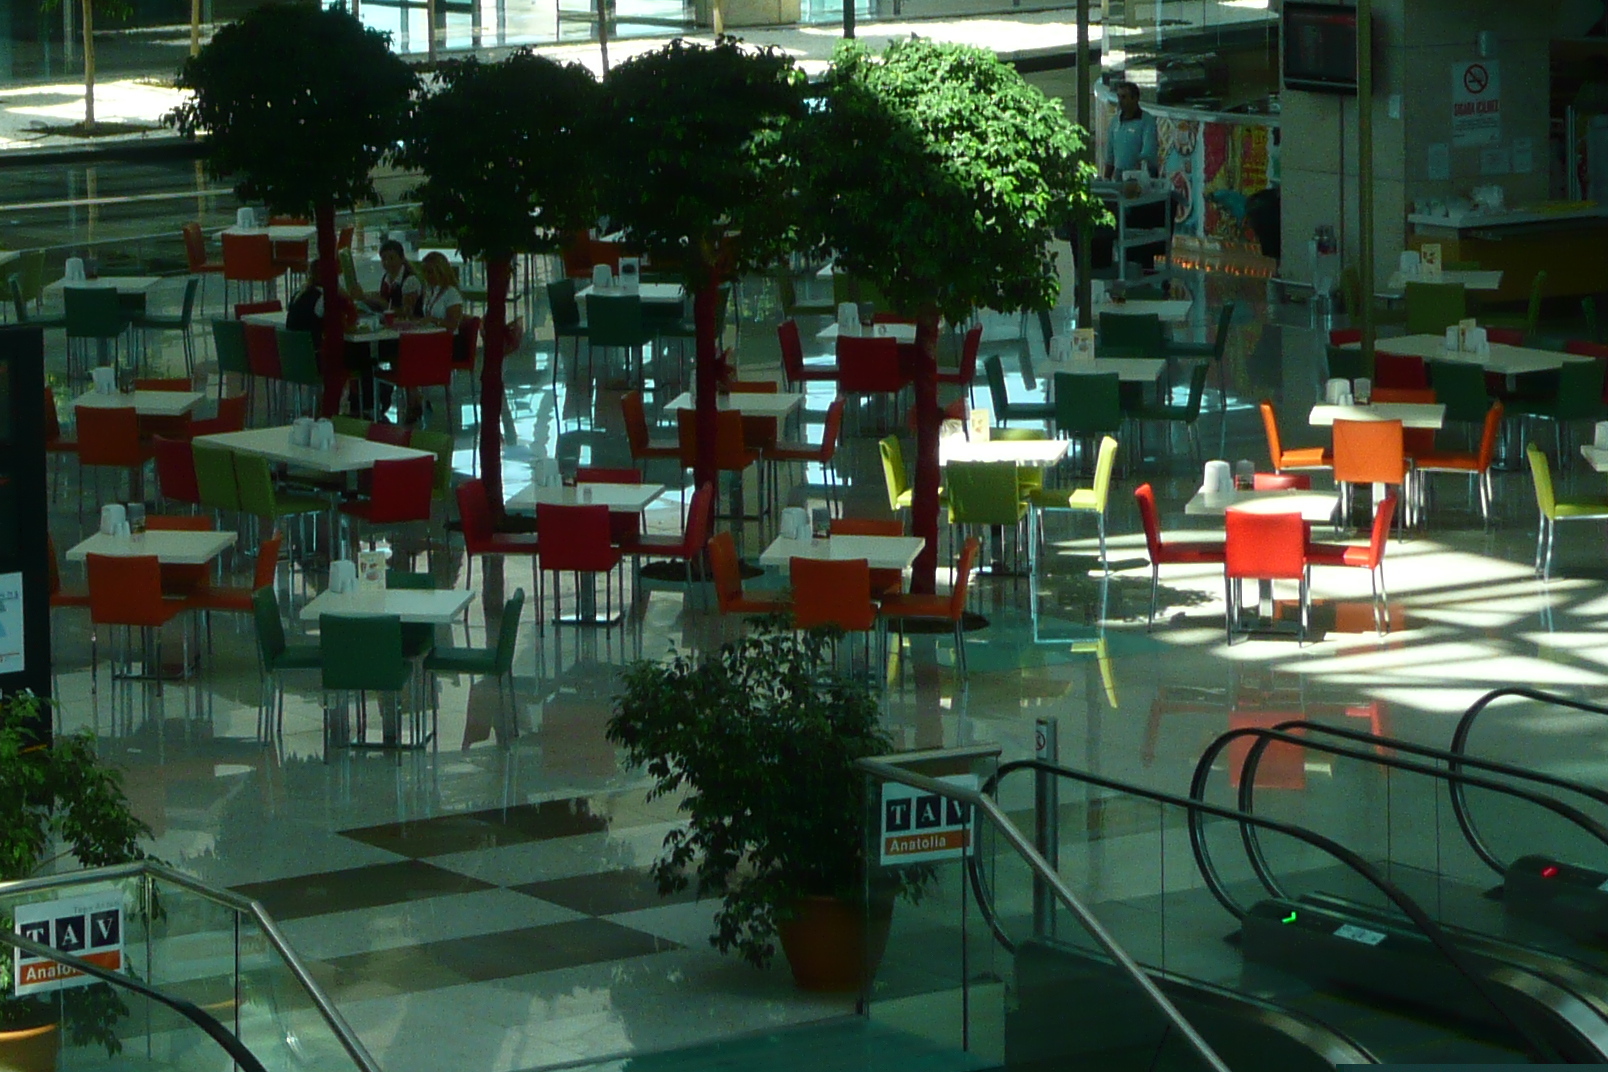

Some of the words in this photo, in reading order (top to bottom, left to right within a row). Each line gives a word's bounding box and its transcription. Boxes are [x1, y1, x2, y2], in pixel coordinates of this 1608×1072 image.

[890, 835, 947, 853] Anatolia
[26, 918, 113, 947] TAV
[26, 963, 80, 981] Anato
